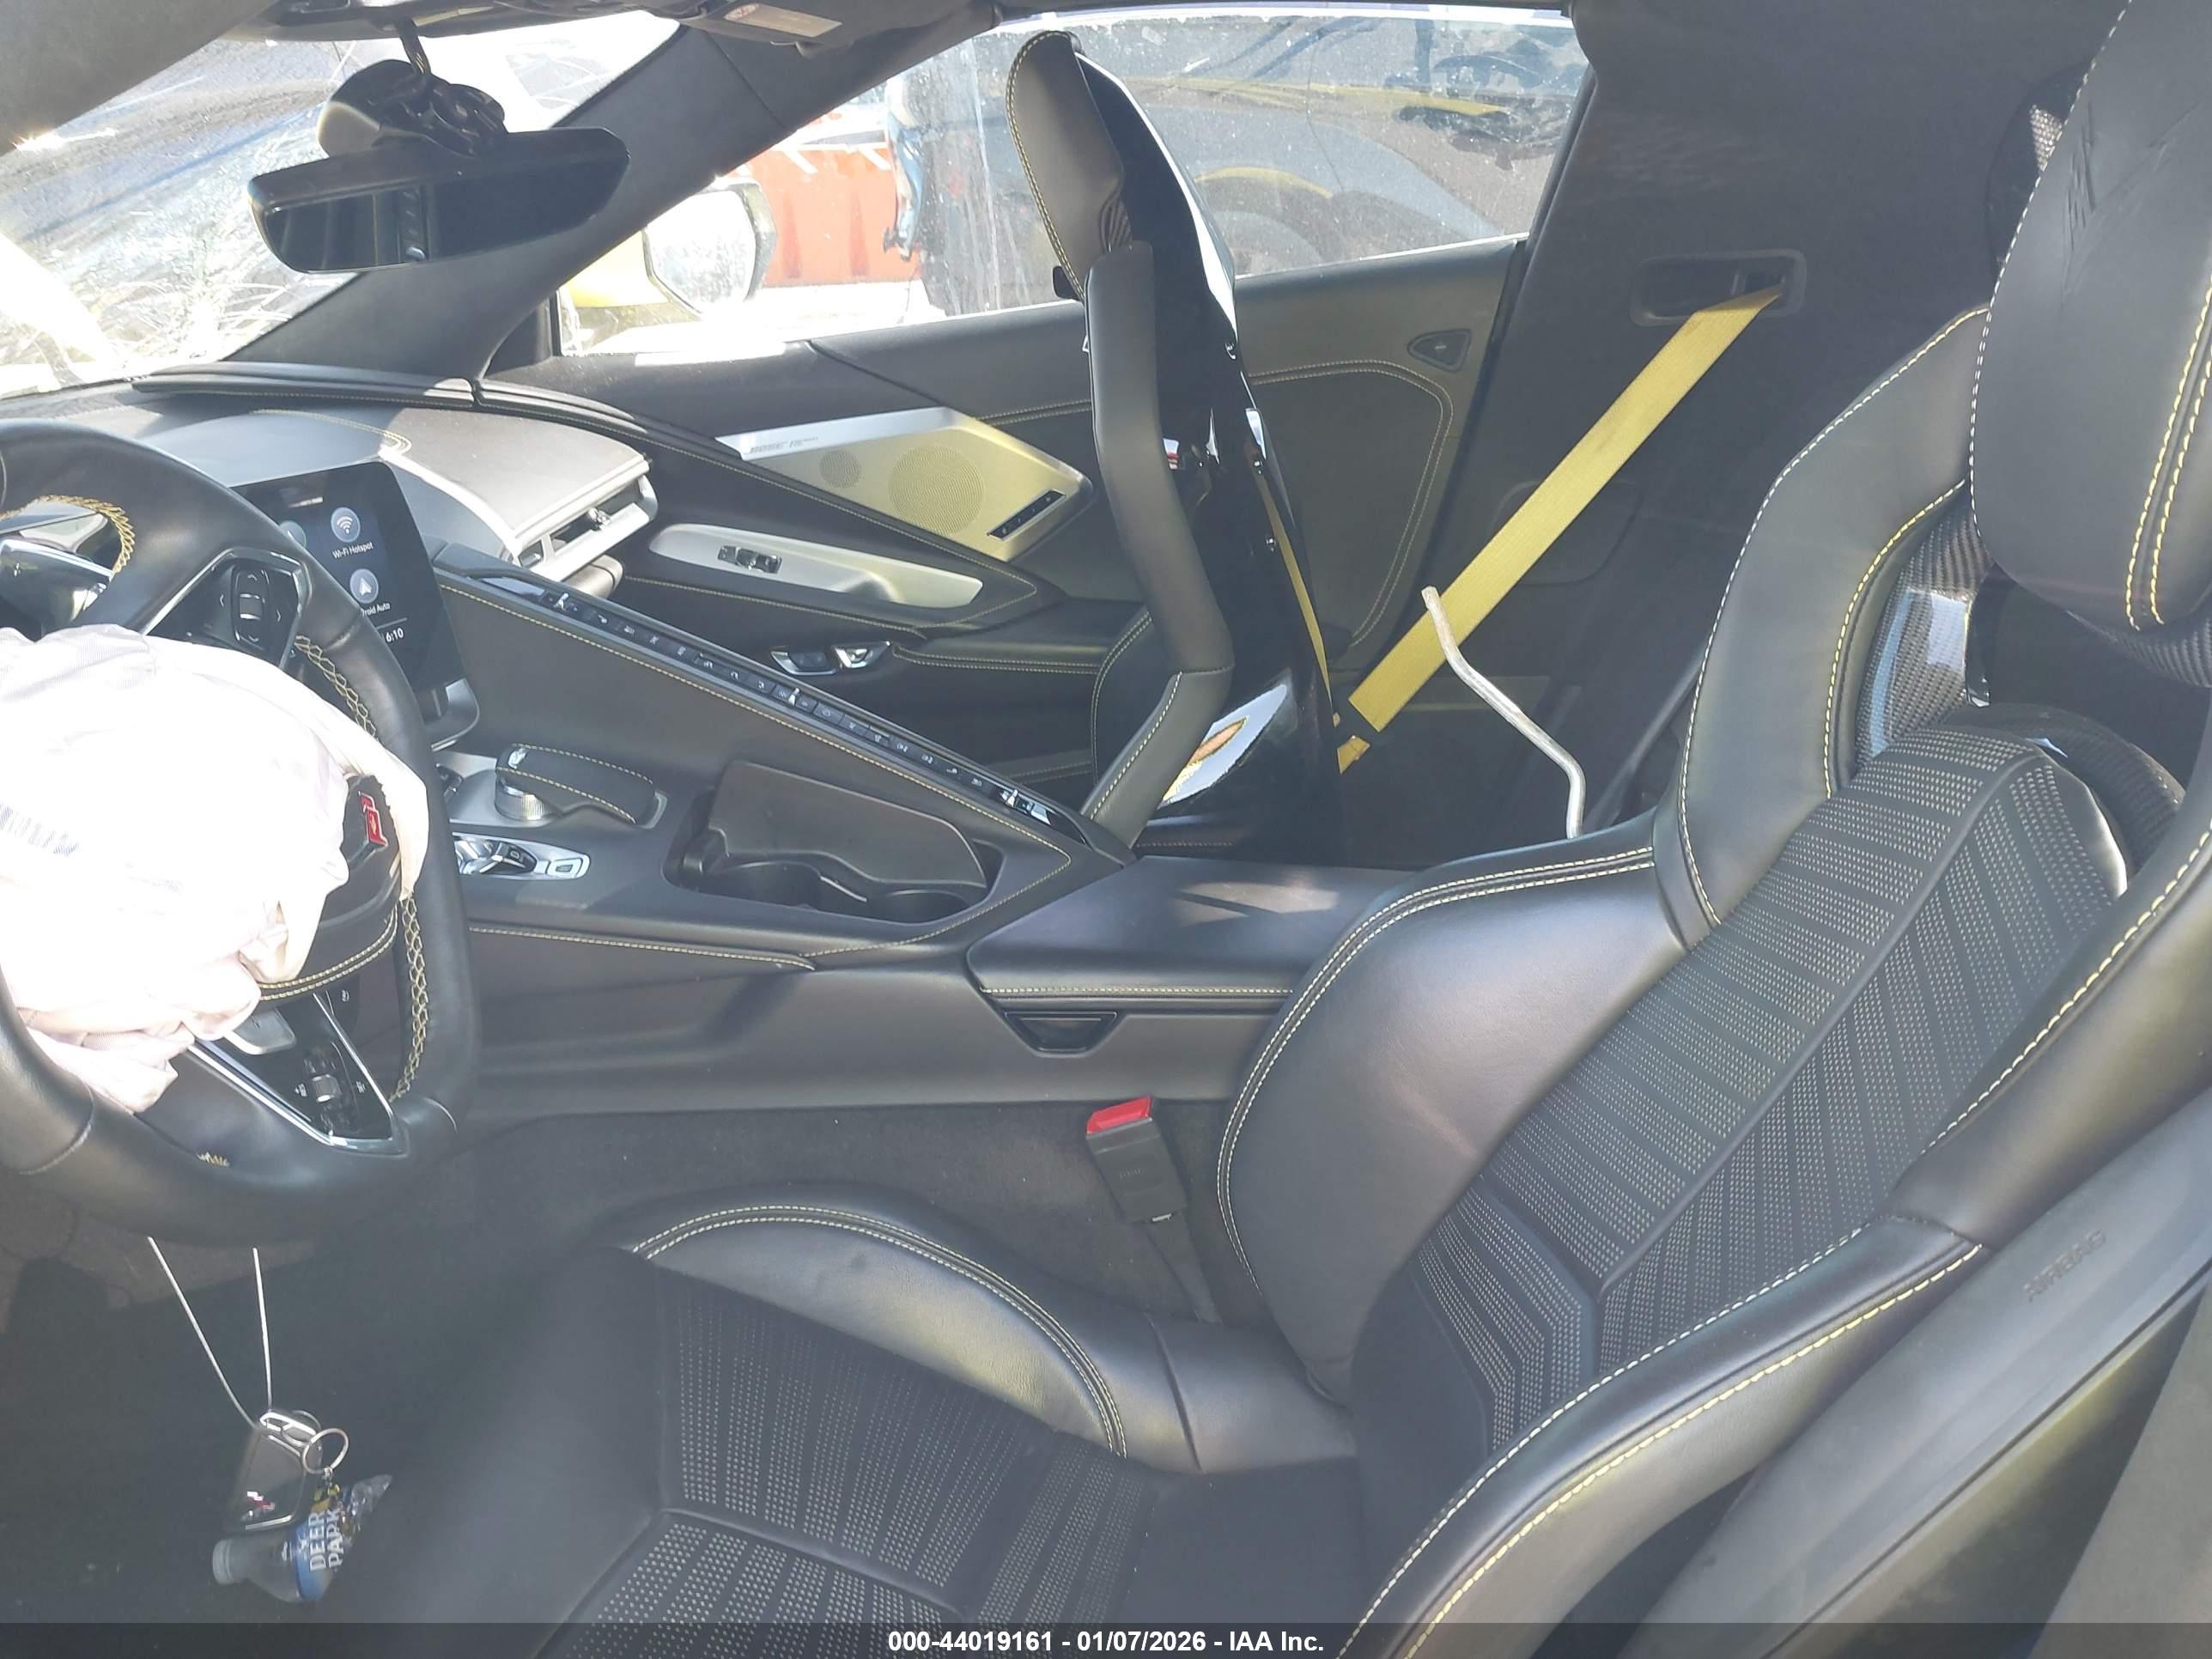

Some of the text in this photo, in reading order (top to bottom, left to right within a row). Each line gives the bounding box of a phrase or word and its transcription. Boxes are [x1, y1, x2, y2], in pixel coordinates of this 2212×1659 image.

[331, 541, 374, 559] Wi-Fi Hotspot
[376, 603, 391, 612] Auto
[386, 628, 404, 642] 6:10
[308, 1510, 326, 1571] DEER
[326, 1508, 344, 1569] PARK
